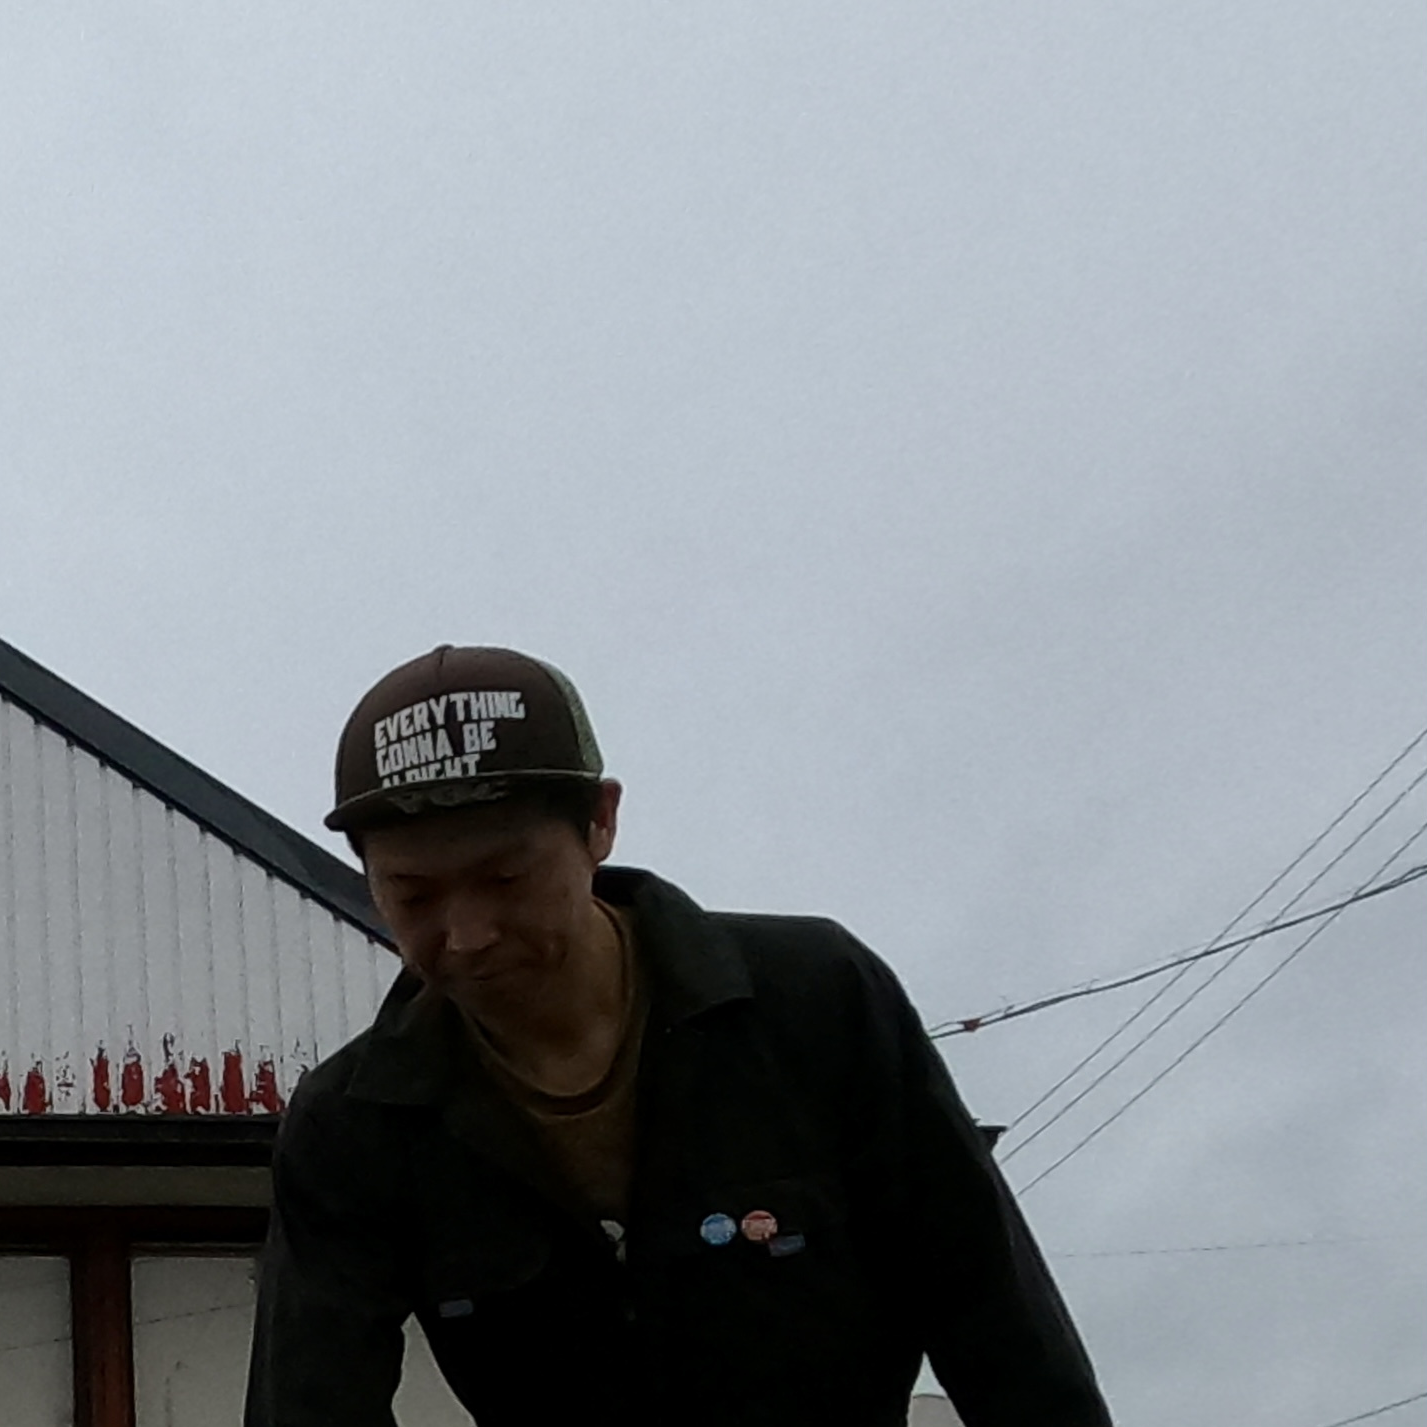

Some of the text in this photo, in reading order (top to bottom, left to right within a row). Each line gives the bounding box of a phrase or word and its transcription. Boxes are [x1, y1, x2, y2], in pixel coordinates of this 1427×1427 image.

[374, 691, 526, 749] EVERYTHING
[376, 720, 497, 778] GONNA BE
